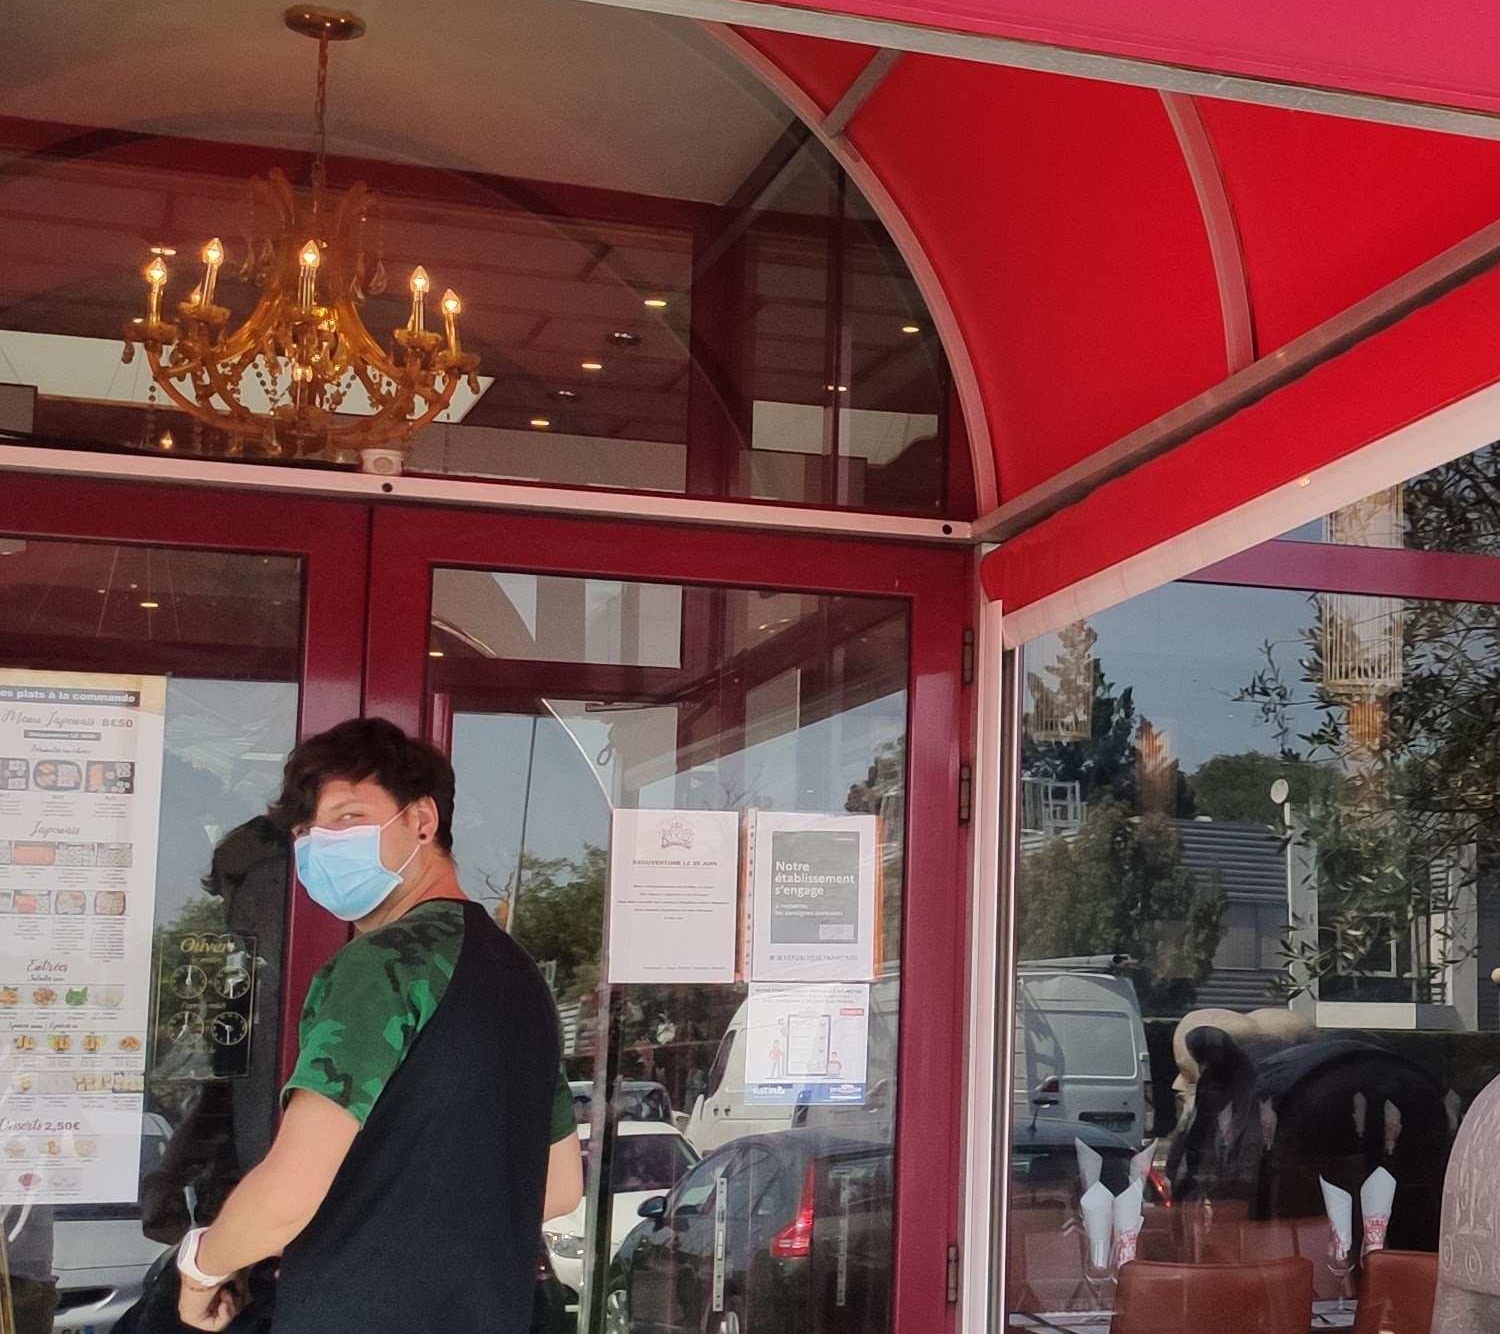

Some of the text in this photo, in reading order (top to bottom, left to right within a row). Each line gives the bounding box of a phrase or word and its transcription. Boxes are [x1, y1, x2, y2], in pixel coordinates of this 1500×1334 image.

[16, 689, 46, 700] plats
[58, 690, 70, 700] la
[72, 692, 136, 703] commande
[29, 820, 81, 838] Japonais
[775, 860, 810, 872] Notre
[774, 872, 856, 884] établissement
[180, 936, 233, 954] Ouver
[0, 1117, 80, 1133] Dserts 2,50€
